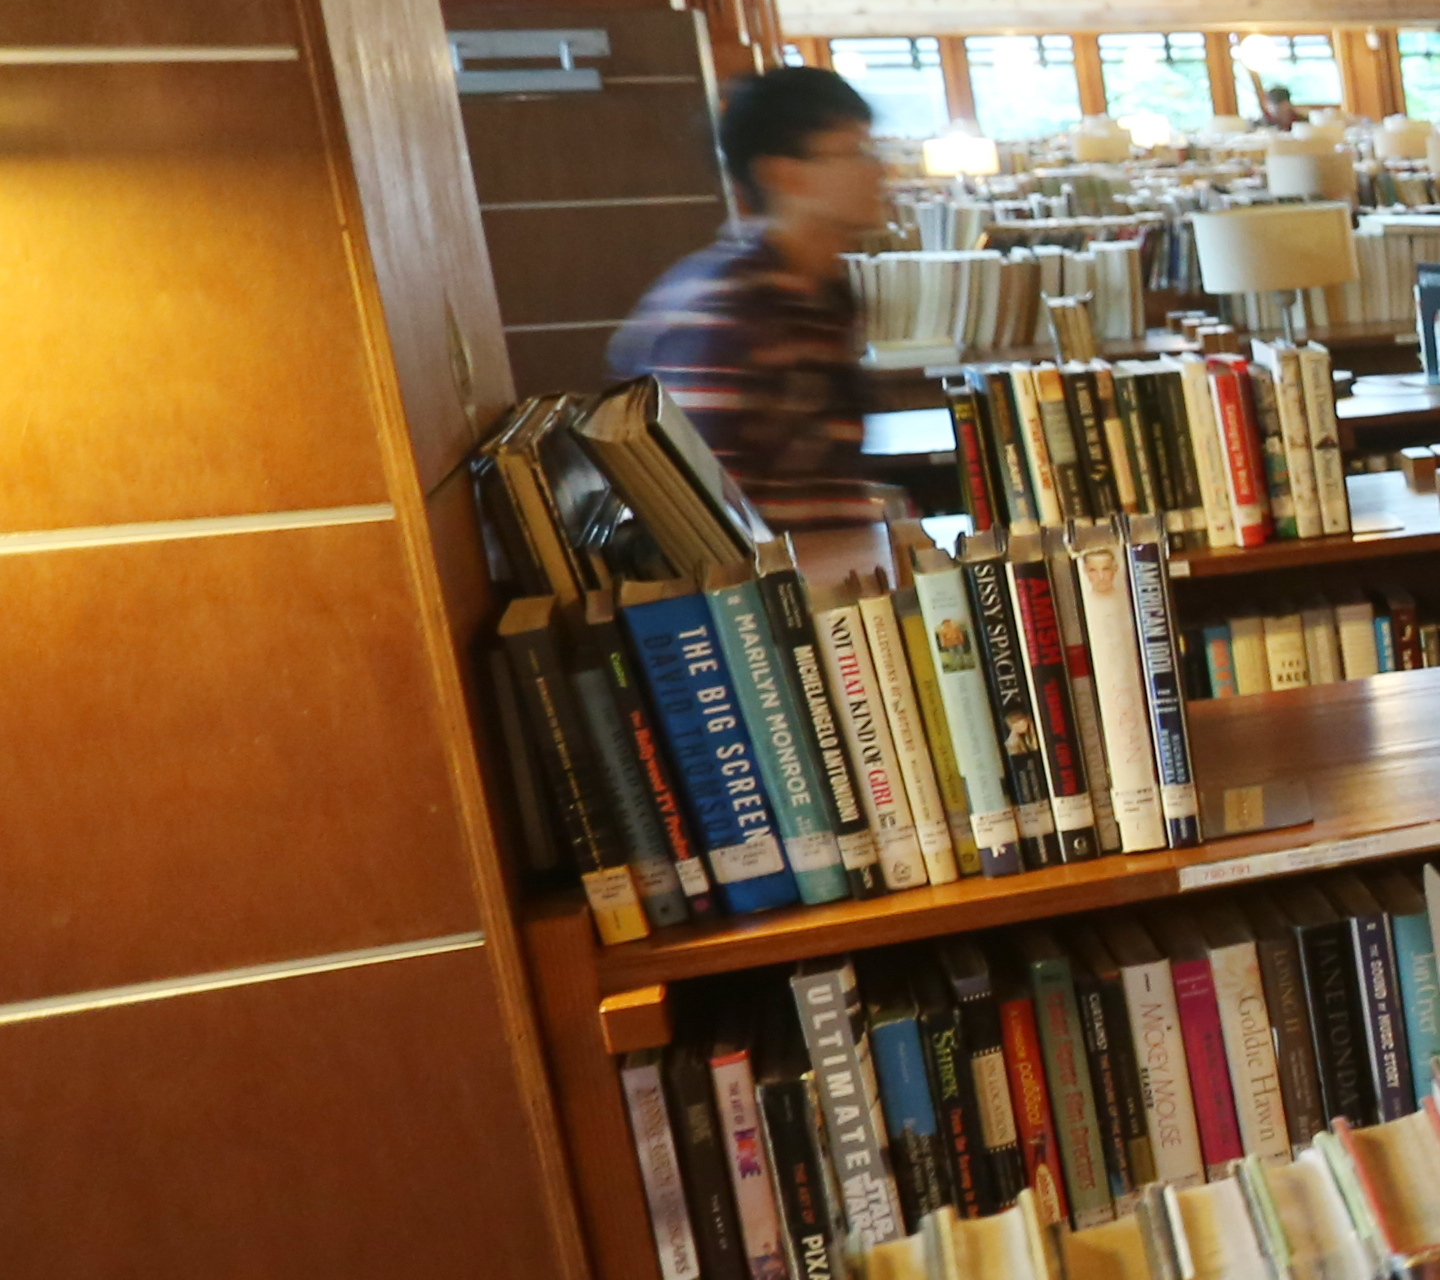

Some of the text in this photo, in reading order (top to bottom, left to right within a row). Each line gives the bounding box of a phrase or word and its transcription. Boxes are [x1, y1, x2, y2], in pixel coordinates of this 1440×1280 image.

[642, 630, 695, 718] DAVID
[973, 563, 1020, 707] SISSY SPACEK
[1030, 575, 1059, 665] AMISH
[1135, 557, 1173, 678] AMERICAN IDOL
[631, 726, 677, 816] Hollywood TV
[676, 623, 772, 844] THE BIG SCREEN
[735, 612, 811, 808] MARILYN MONROE
[793, 644, 860, 823] MICHELANGELO ANTONIONI
[830, 616, 894, 811] NOT THAT KIND OF GIRL
[1272, 949, 1299, 1013] LOSING
[1316, 937, 1361, 1106] JANE FONDA
[1368, 959, 1401, 1089] SOUND MUSIC STORY
[806, 983, 873, 1171] ULTIMATE
[1139, 1004, 1182, 1149] MICKEY MOUSE
[1236, 995, 1276, 1143] Goldie Hawn
